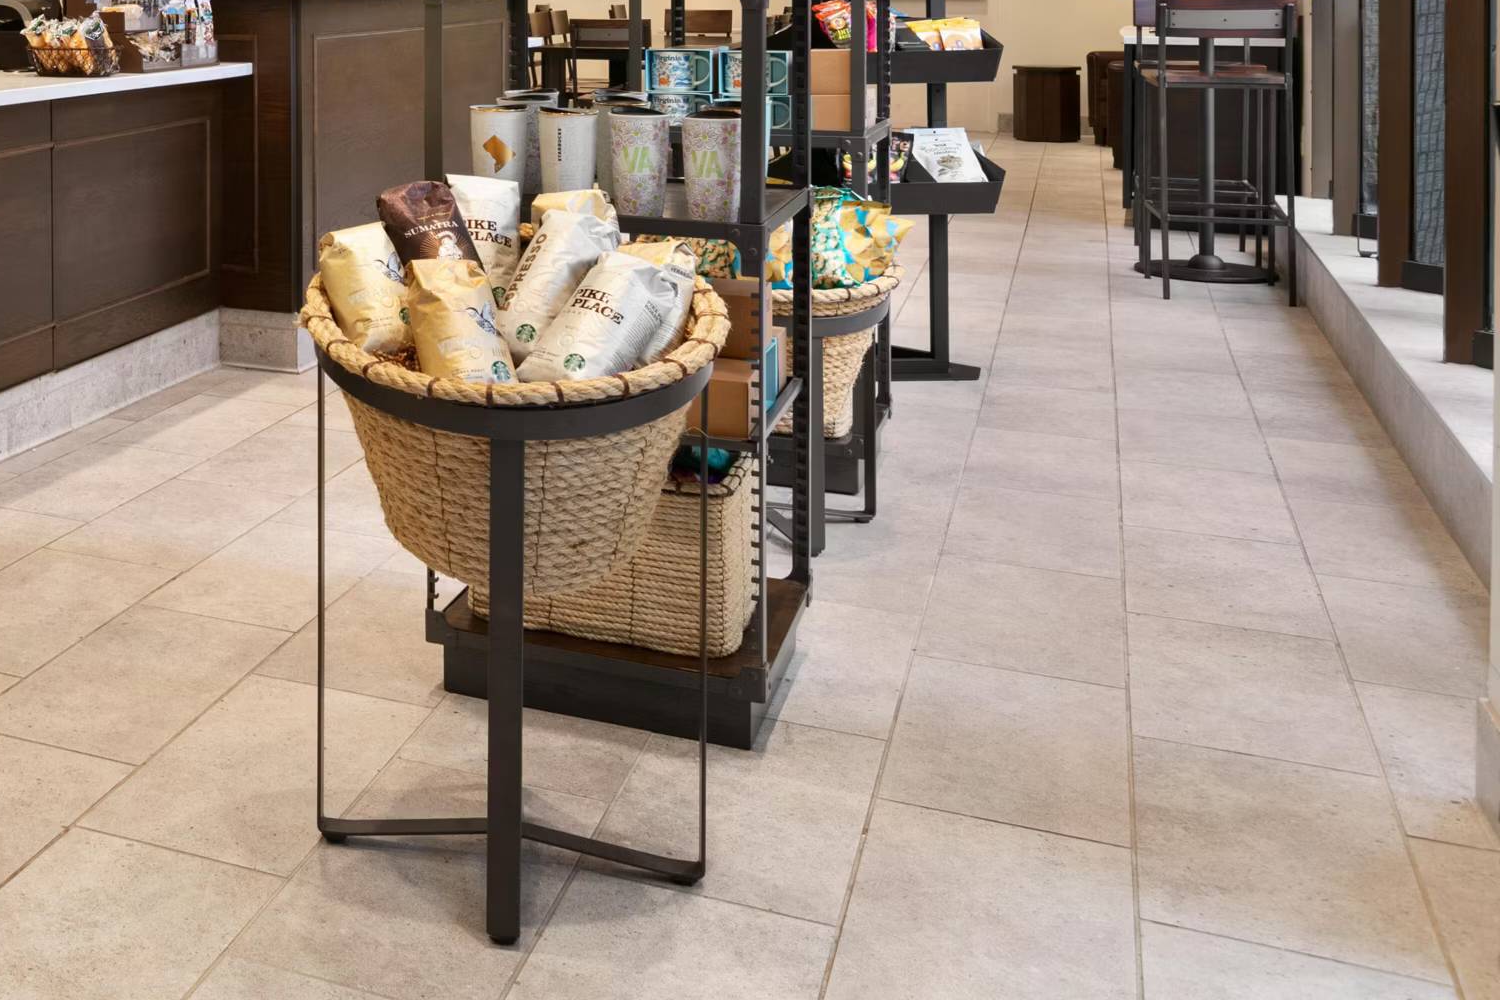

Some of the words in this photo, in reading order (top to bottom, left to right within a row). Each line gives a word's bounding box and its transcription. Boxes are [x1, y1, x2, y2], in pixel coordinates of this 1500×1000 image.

[618, 146, 653, 174] VA
[690, 150, 723, 178] VA
[404, 220, 460, 239] SUMATRA
[464, 219, 497, 231] IKE
[572, 299, 624, 325] PLACE
